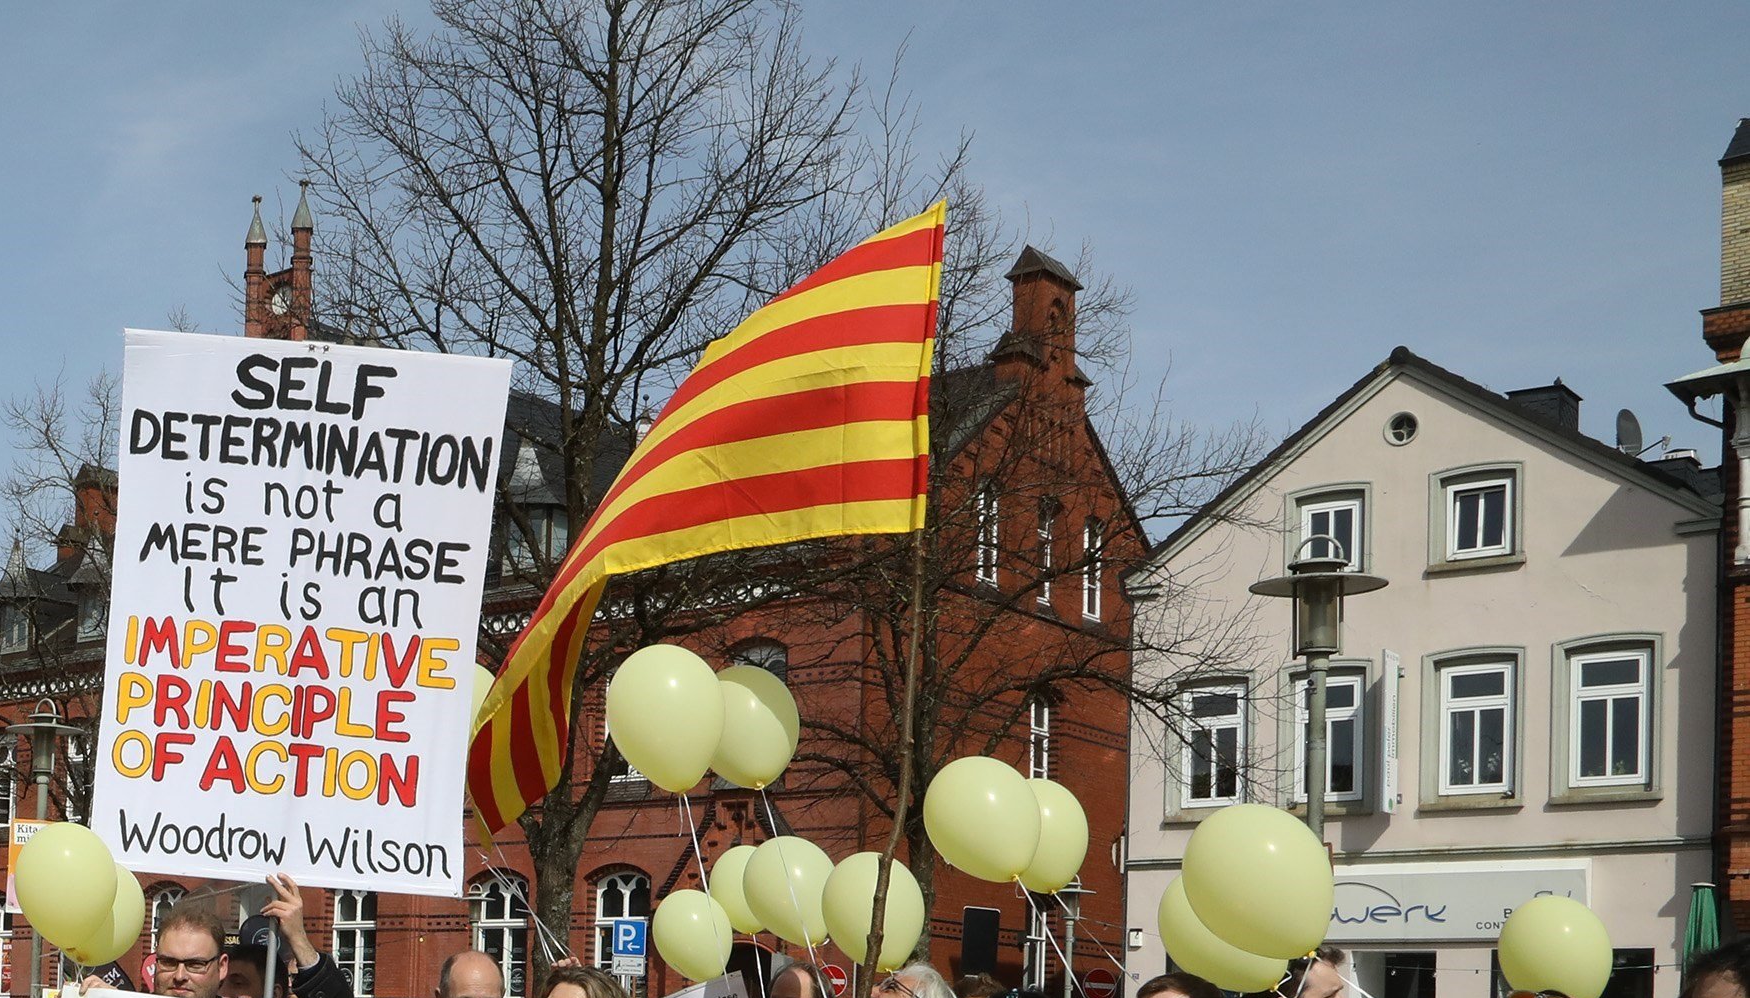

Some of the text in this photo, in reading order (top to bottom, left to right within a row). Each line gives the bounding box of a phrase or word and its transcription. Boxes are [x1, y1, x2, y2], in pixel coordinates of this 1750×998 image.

[231, 354, 398, 420] SELF
[130, 409, 492, 493] DETERMINATION
[184, 472, 402, 532] is not a
[139, 523, 470, 584] MERE PHRASE
[183, 568, 422, 629] It is an
[125, 616, 460, 690] IMPERATIVE
[115, 672, 416, 743] PRINCIPLE
[112, 731, 419, 808] OF ACTION
[119, 808, 452, 880] Woodrow Wilson
[619, 924, 636, 951] P
[1330, 905, 1446, 924] werk
[1476, 921, 1505, 930] CONT
